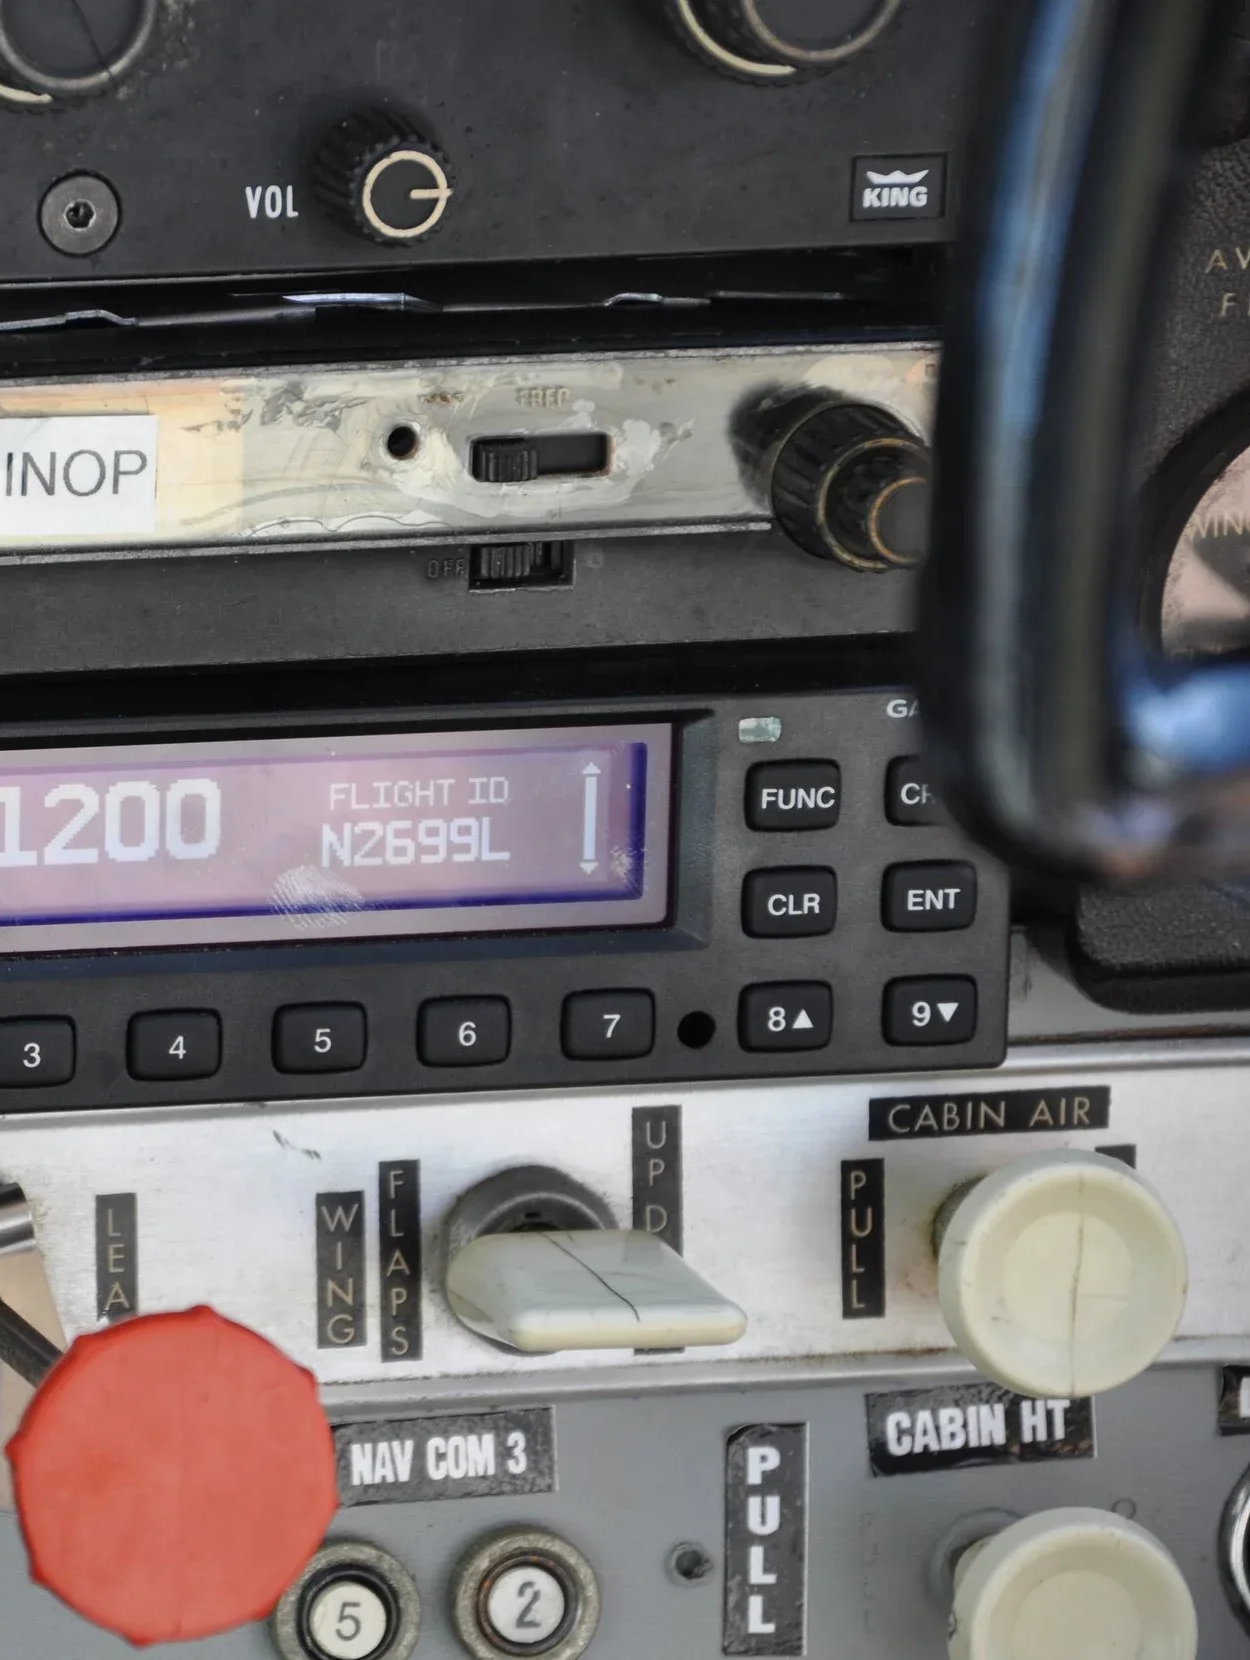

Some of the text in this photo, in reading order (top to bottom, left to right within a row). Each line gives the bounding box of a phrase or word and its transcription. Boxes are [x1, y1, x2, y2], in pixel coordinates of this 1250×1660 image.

[245, 185, 298, 218] VOL
[863, 187, 928, 208] KING
[4, 449, 148, 497] INOP
[330, 776, 508, 811] FLIGHT ID
[761, 786, 835, 809] FUNC
[321, 817, 510, 868] N2699L
[768, 893, 820, 916] CLR
[907, 888, 961, 911] ENT
[603, 1014, 621, 1038] 7
[768, 1007, 786, 1032] 8
[912, 1001, 931, 1027] 9
[169, 1035, 187, 1060] 4
[314, 1028, 332, 1053] 5
[458, 1021, 477, 1046] 6
[23, 1043, 41, 1068] 3
[887, 1098, 1090, 1134] CABIN AIR
[646, 1120, 667, 1186] UP
[850, 1170, 873, 1310] PULL
[321, 1203, 359, 1345] WING
[387, 1170, 410, 1355] FLAPS
[886, 1399, 1070, 1457] CABIN HT
[351, 1432, 527, 1485] NAV COM 3
[747, 1446, 781, 1634] PULL
[335, 1602, 362, 1641] 5
[516, 1580, 542, 1629] 2
